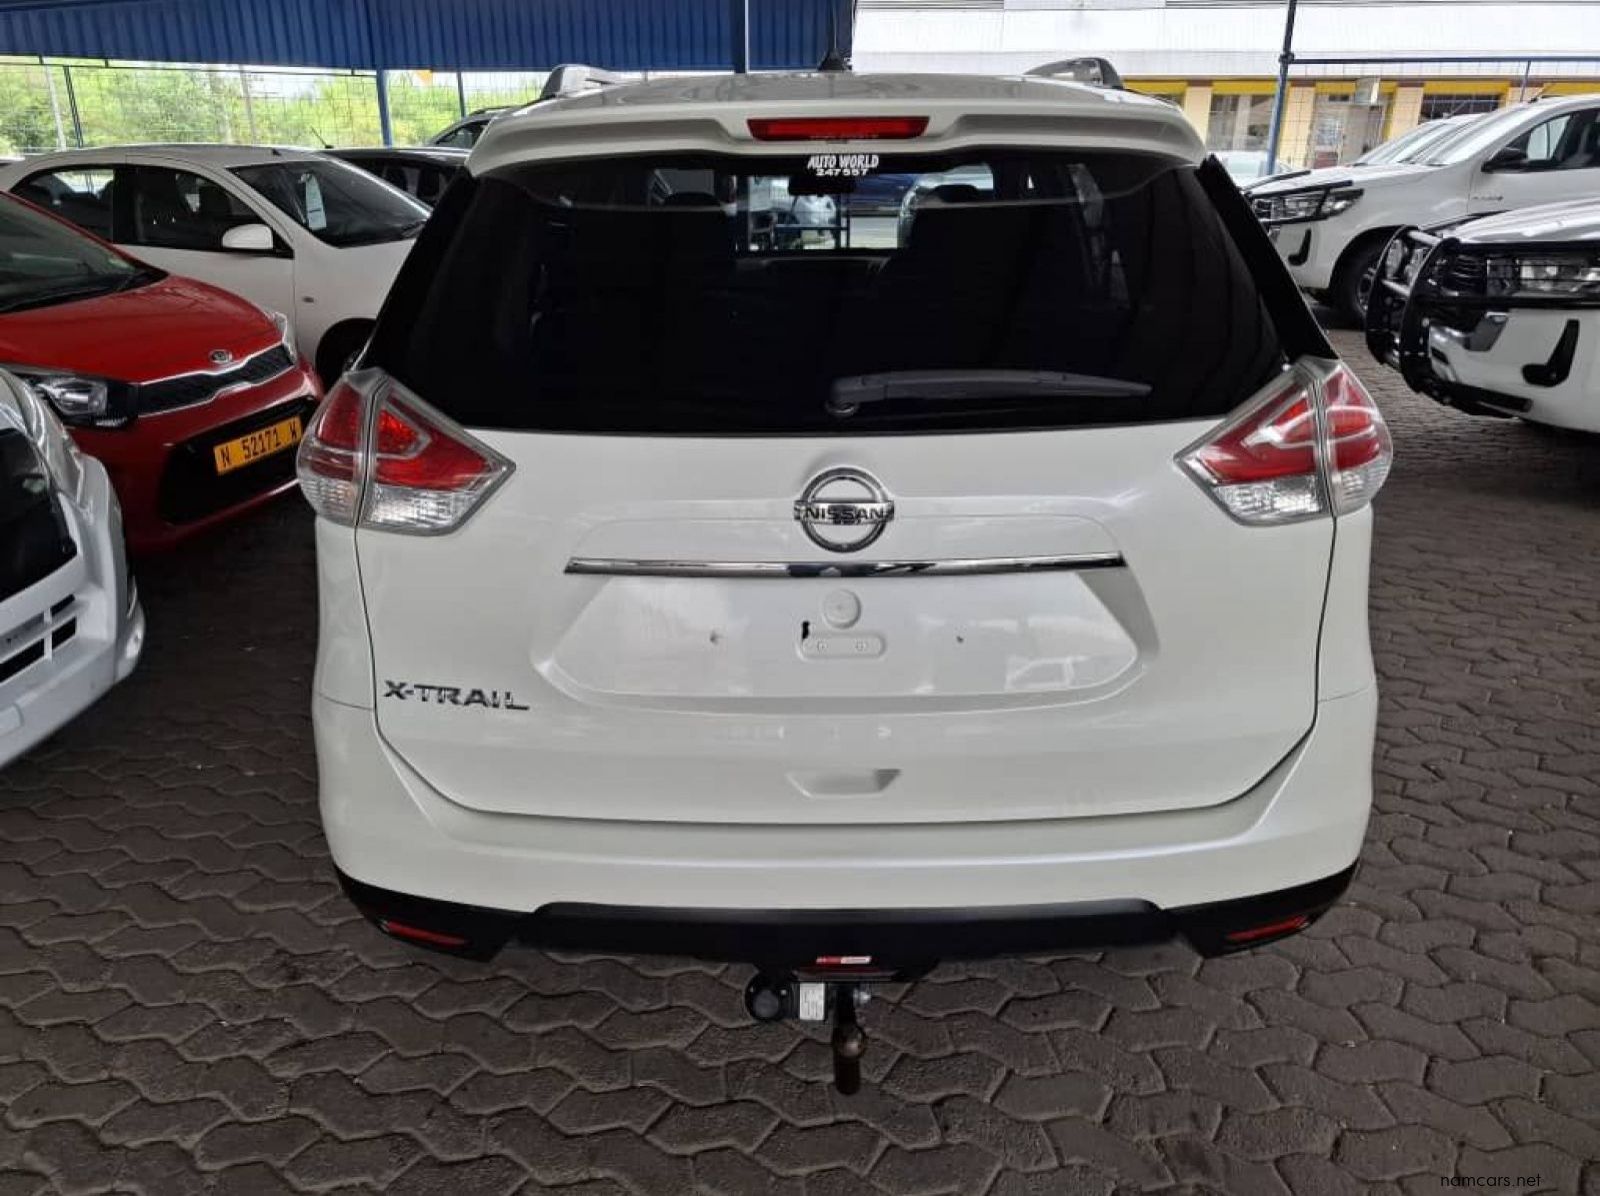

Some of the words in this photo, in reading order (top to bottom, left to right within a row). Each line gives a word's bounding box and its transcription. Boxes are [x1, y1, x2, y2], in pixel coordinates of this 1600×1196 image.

[807, 154, 837, 169] AUTO
[839, 154, 879, 169] WORLD
[220, 445, 231, 469] N
[242, 427, 281, 460] 52171
[805, 505, 885, 521] NISSAN
[384, 680, 530, 711] X-TRAIL
